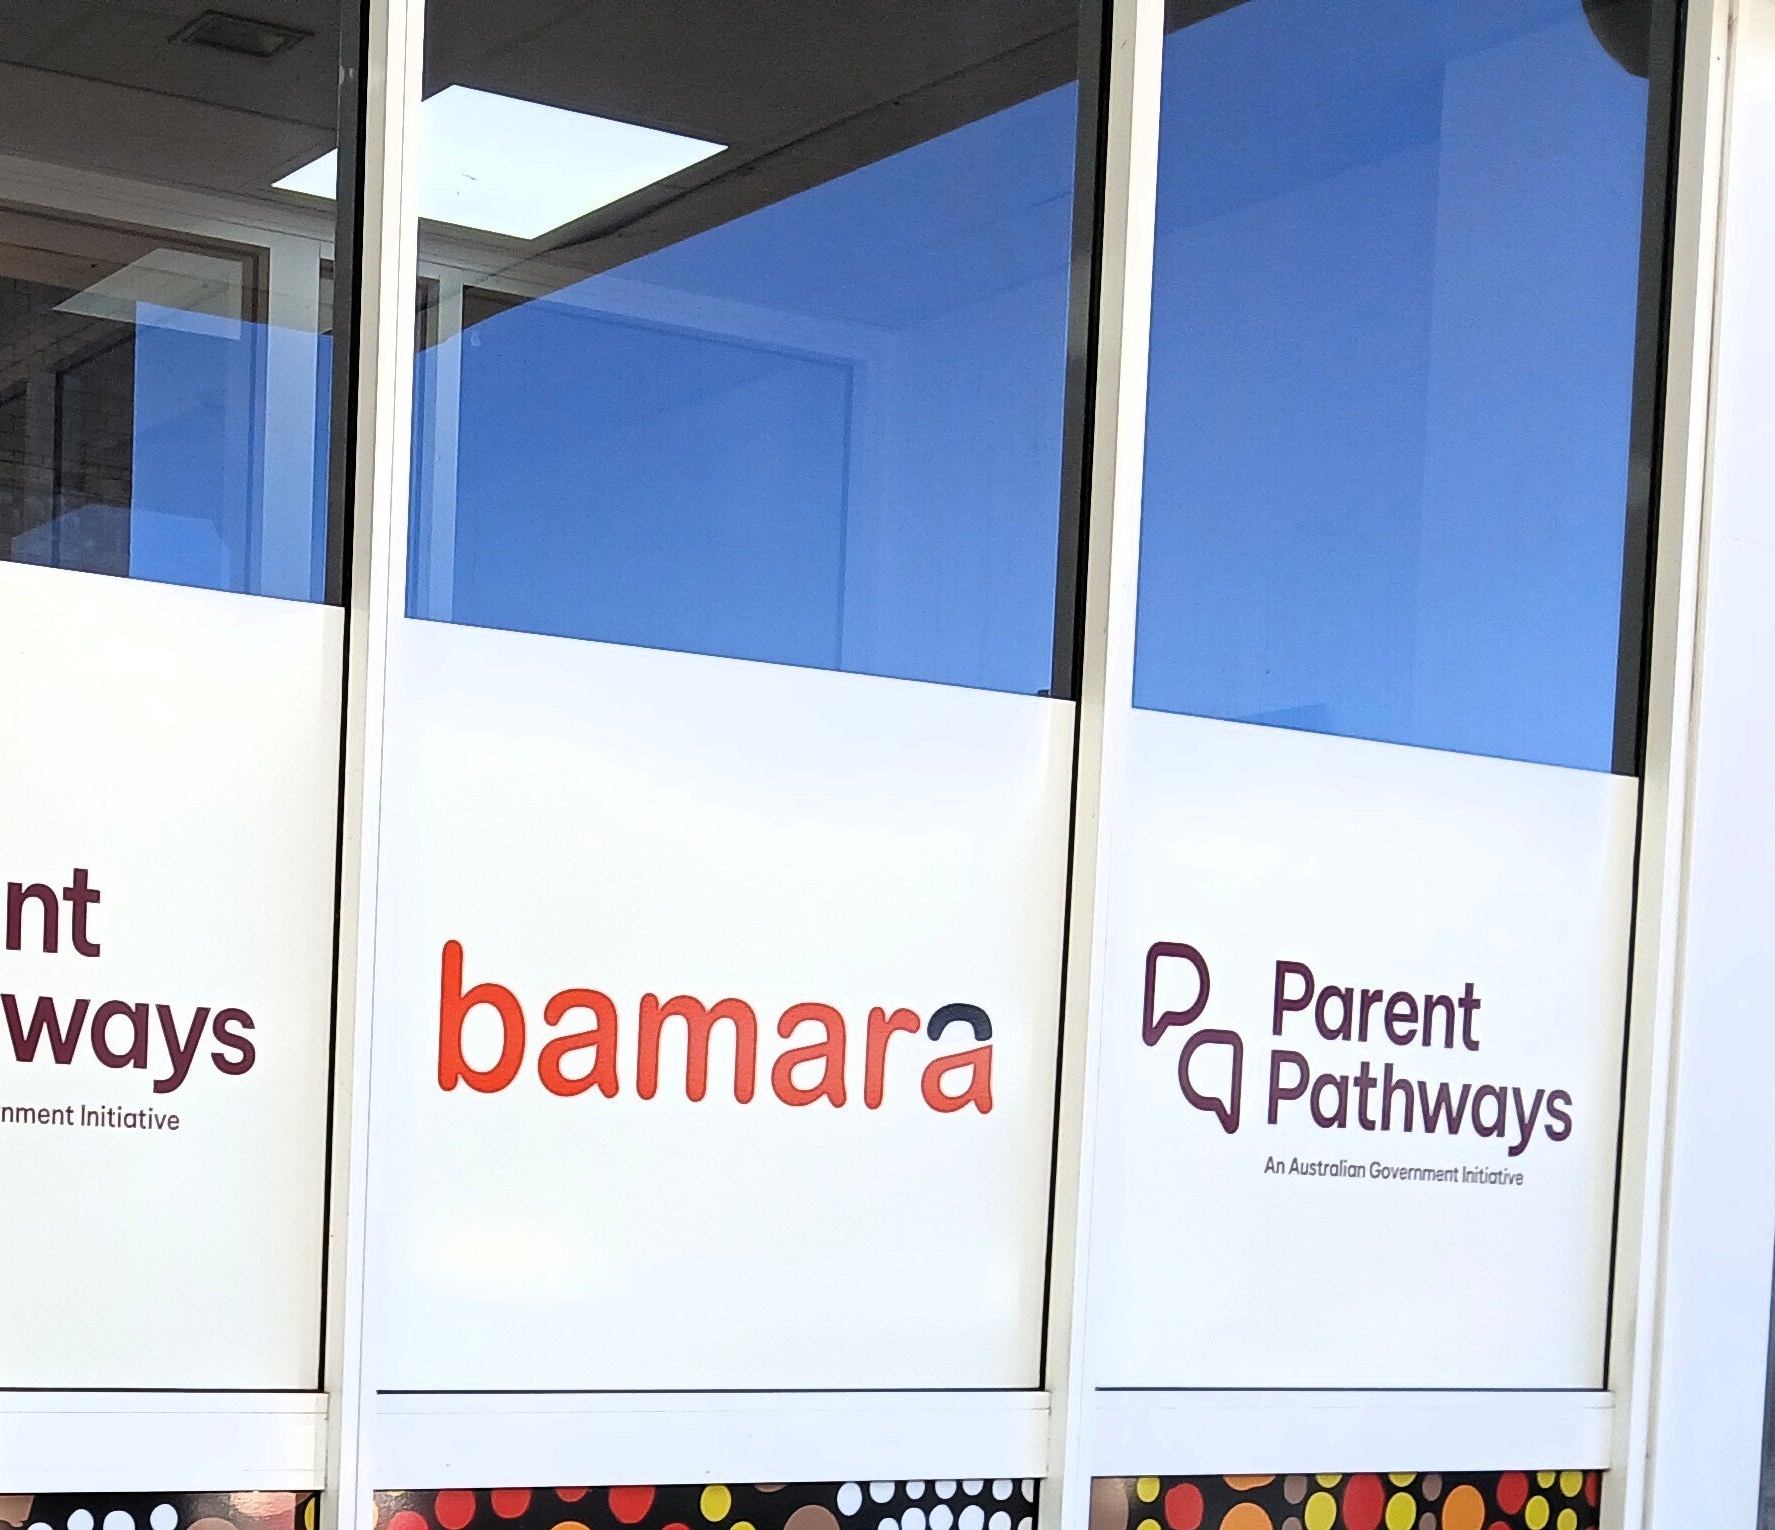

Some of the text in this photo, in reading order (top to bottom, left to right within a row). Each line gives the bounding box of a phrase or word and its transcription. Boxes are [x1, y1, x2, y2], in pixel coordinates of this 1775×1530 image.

[438, 940, 993, 1114] bamara
[1273, 960, 1481, 1051] Parent
[81, 1105, 179, 1130] Initiative
[1268, 1050, 1572, 1157] Pathways
[1264, 1156, 1523, 1185] An Australian Government Initiative
